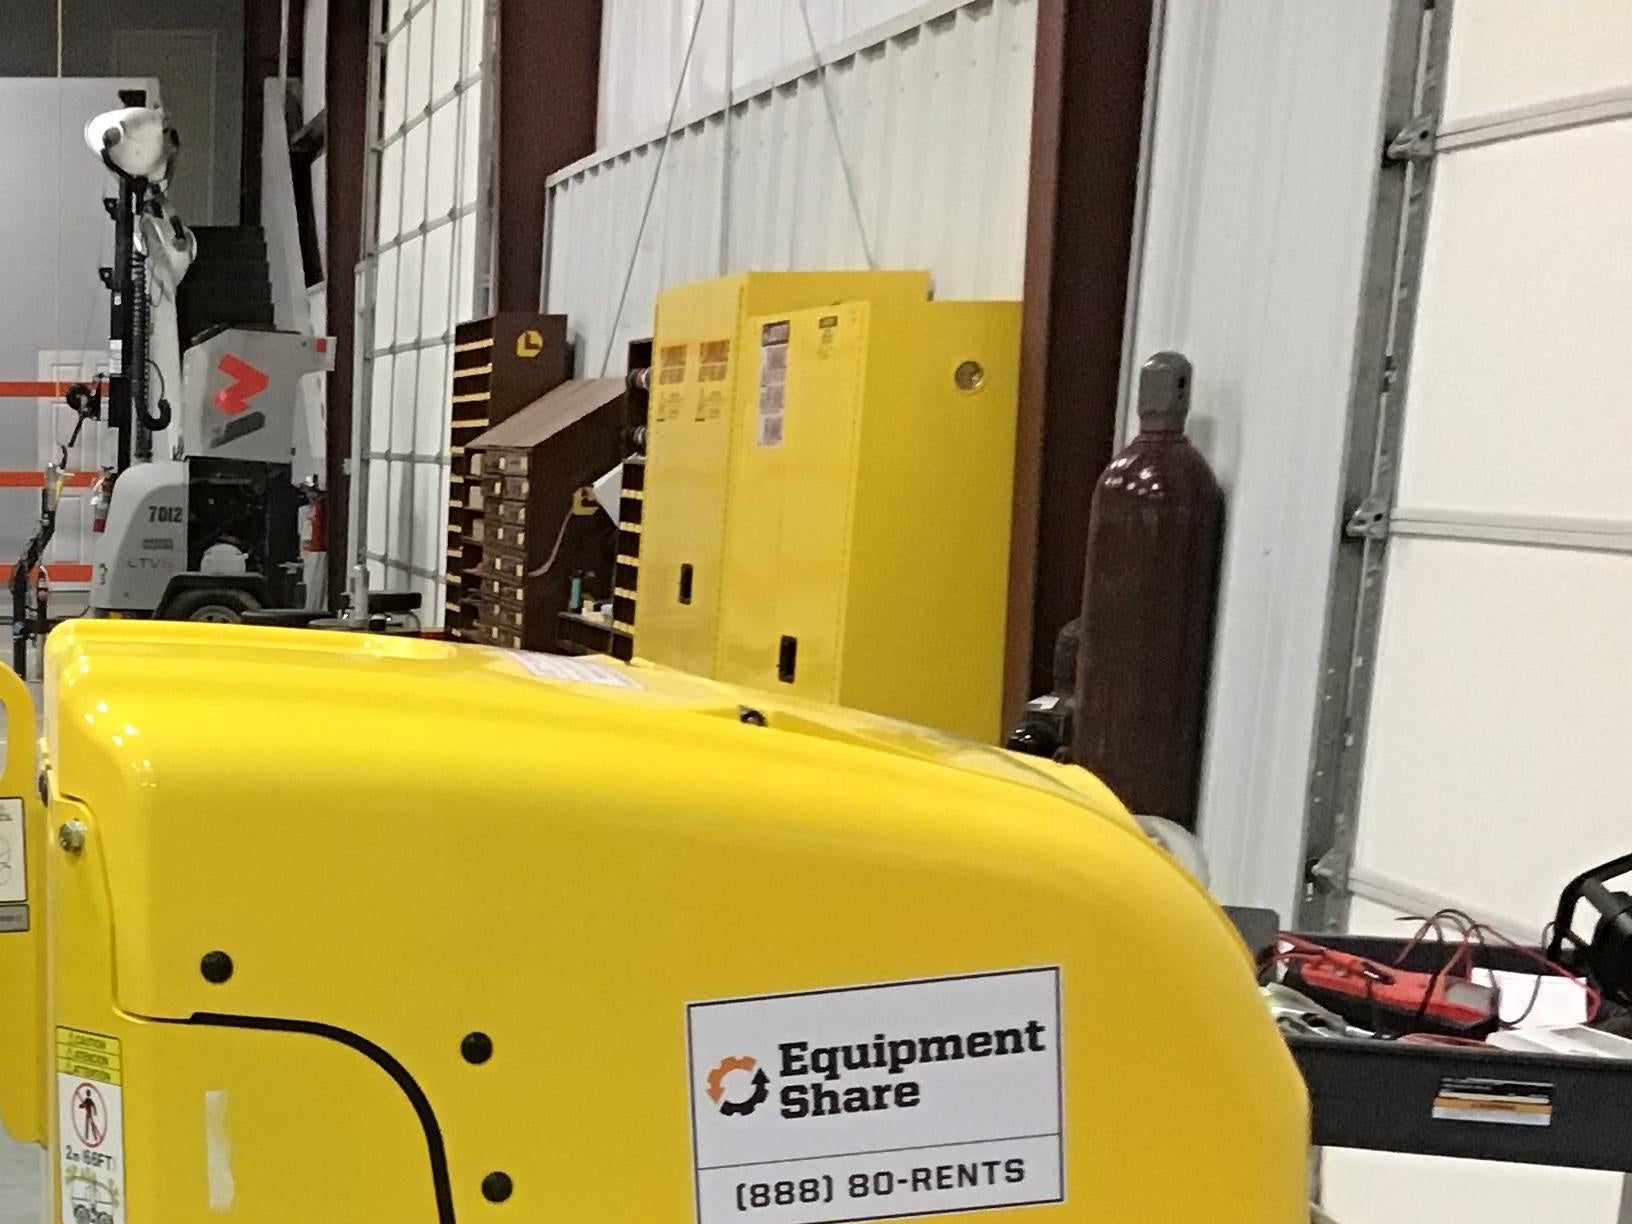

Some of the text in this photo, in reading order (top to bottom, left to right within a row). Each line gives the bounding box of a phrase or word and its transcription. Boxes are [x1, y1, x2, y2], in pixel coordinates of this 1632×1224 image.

[149, 506, 183, 522] 7012
[779, 1020, 1046, 1080] Equipment
[779, 1080, 921, 1120] Share
[736, 1158, 1026, 1212] (888) 80-RENTS
